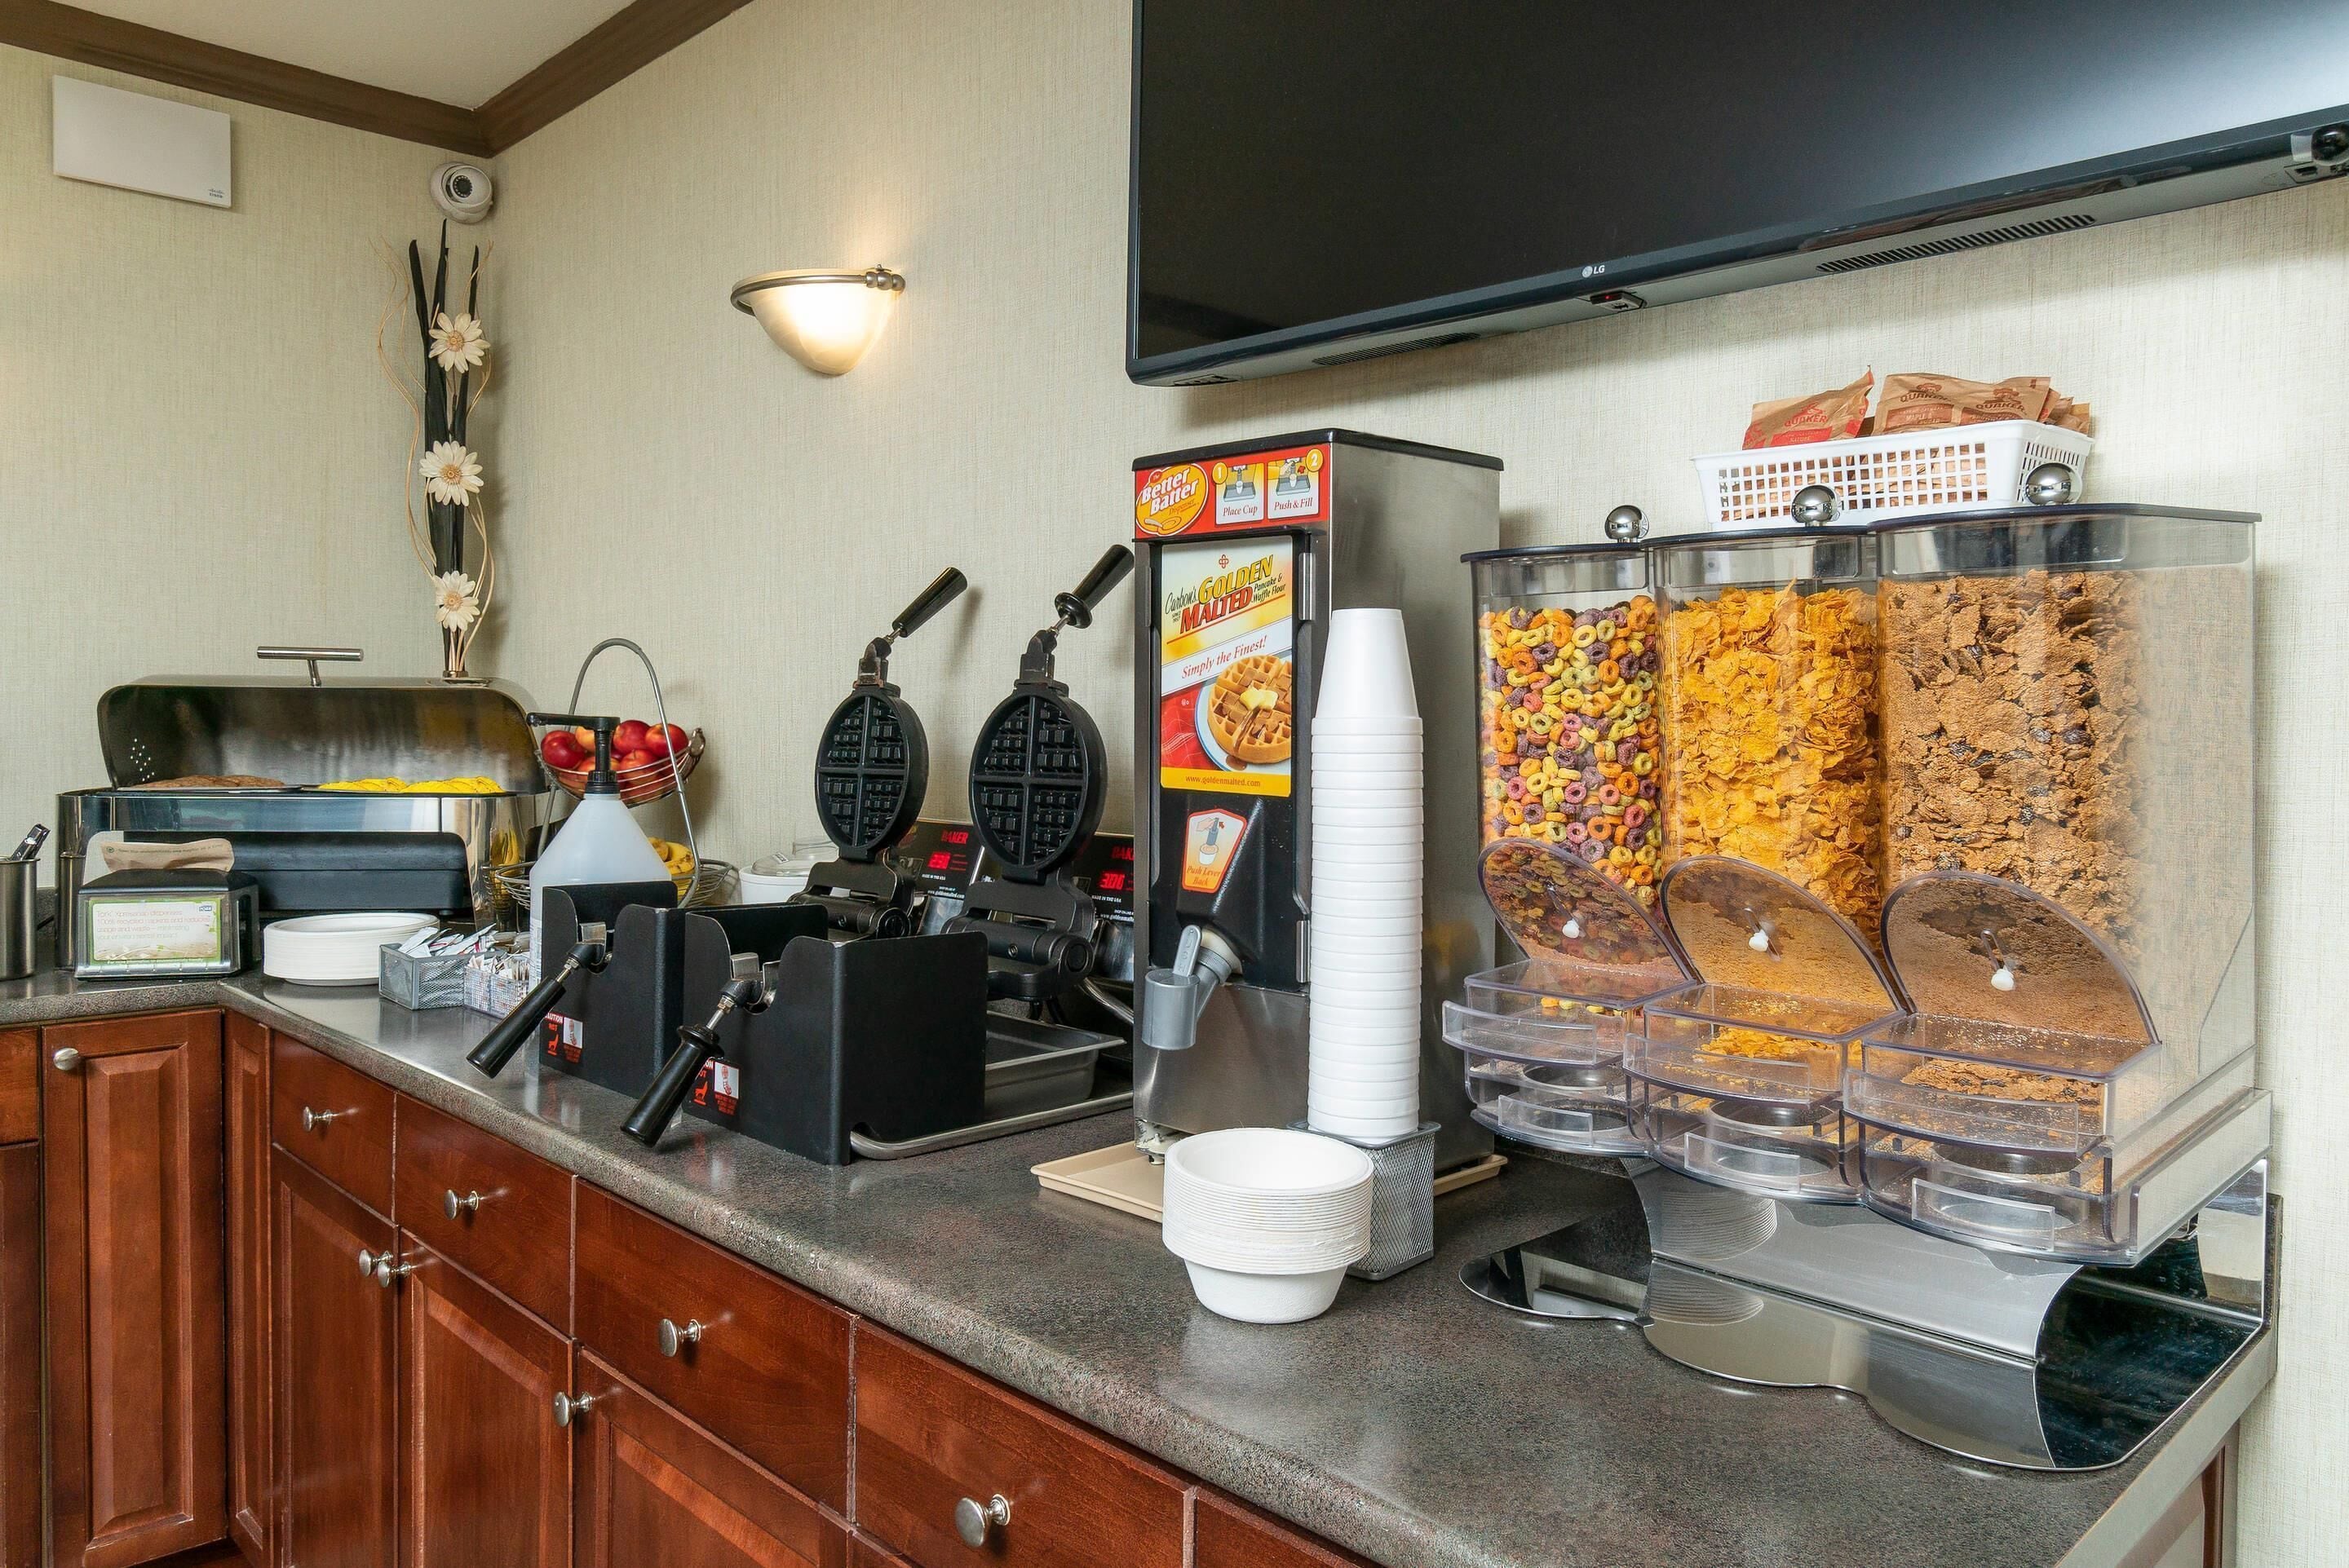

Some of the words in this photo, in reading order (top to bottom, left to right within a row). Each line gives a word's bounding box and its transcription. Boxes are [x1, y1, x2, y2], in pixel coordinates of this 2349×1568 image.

[1593, 265, 1605, 274] LG
[1975, 403, 2025, 413] QUAKER
[1784, 414, 1829, 427] QUAKER
[1311, 454, 1318, 467] 2
[1217, 469, 1223, 479] 1
[1140, 466, 1191, 506] Better
[1150, 478, 1199, 517] Batter
[1273, 500, 1294, 510] Push
[1294, 500, 1299, 509] &
[1300, 497, 1313, 508] Fill
[1223, 506, 1242, 516] Place
[1242, 504, 1259, 516] Cup
[1165, 585, 1197, 615] Carbon's
[1198, 554, 1274, 604] GOLDEN
[1253, 578, 1277, 593] Pancake
[1253, 589, 1271, 603] Waffle
[1272, 583, 1286, 597] Flour
[1179, 586, 1254, 634] MALTED
[1182, 654, 1214, 679] Simply
[1216, 651, 1232, 665] the
[1234, 635, 1267, 659] Finest!
[1185, 775, 1261, 788] www.goldenmalted.com
[941, 830, 969, 845] BAKER
[1187, 866, 1201, 876] Push
[1201, 867, 1220, 877] Lever
[1192, 877, 1209, 887] Back
[545, 1012, 563, 1024] AUTION
